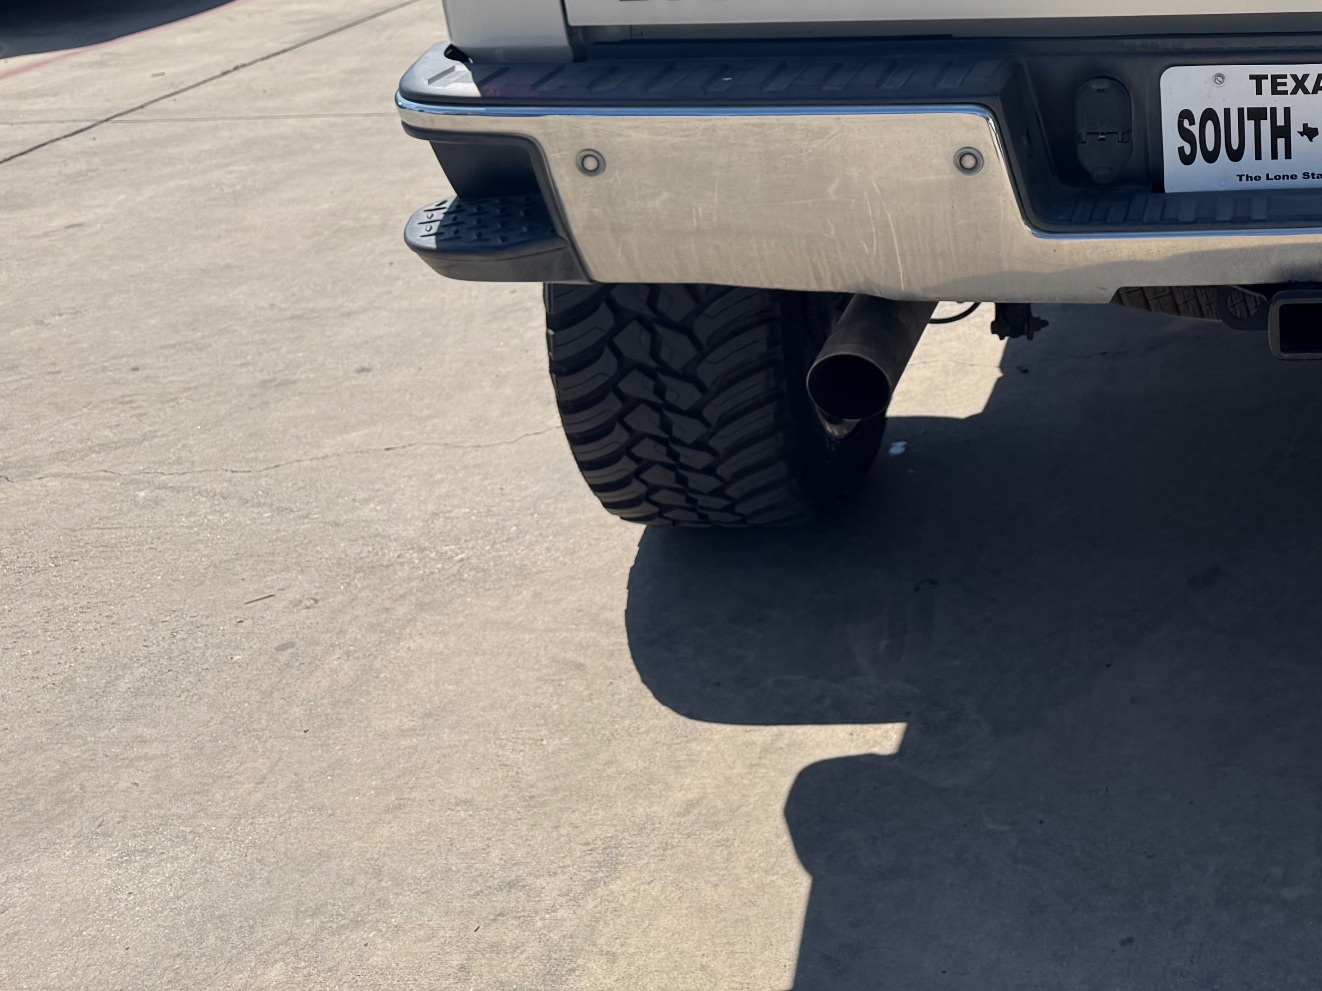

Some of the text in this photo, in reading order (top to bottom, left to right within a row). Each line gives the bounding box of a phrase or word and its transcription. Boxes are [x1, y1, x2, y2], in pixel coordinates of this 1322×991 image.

[1177, 106, 1292, 166] SOUTH
[1236, 173, 1262, 182] The
[1265, 172, 1298, 182] Lone
